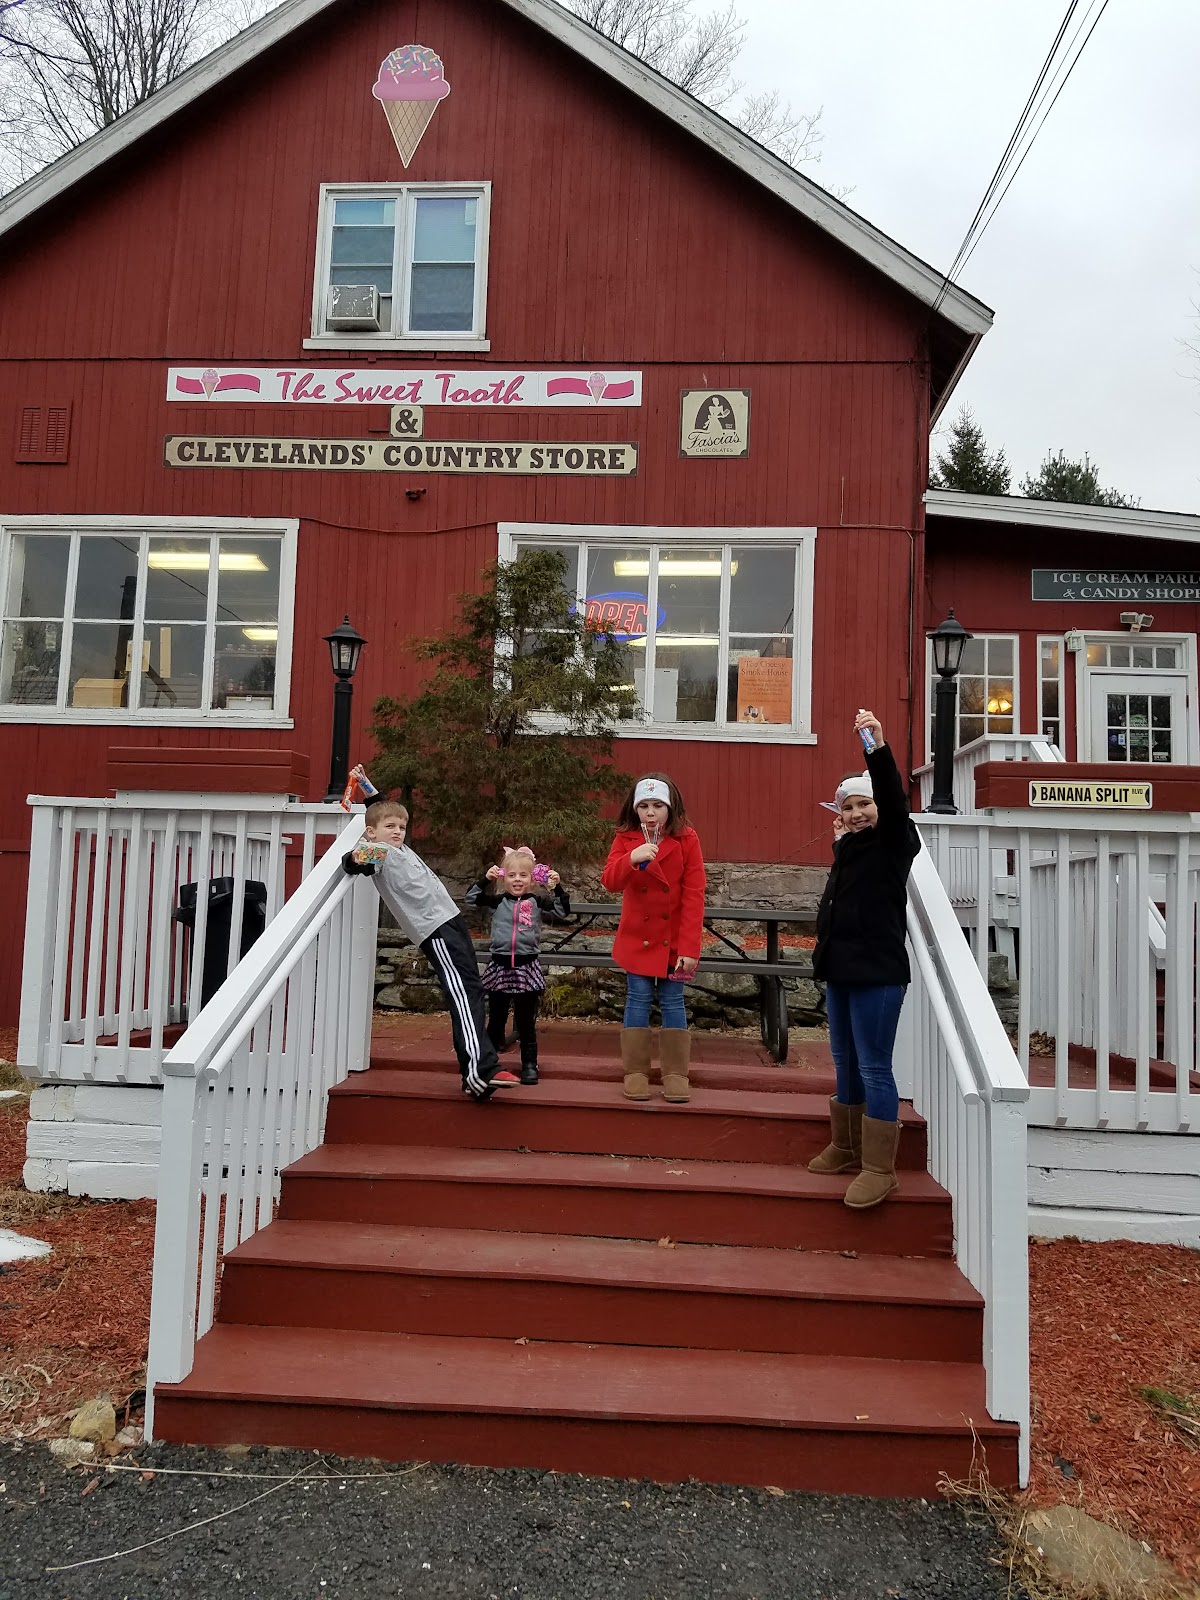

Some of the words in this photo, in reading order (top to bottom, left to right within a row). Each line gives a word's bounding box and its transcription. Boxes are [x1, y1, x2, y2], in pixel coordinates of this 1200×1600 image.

[276, 371, 326, 401] The
[333, 372, 424, 403] Sweet
[434, 373, 525, 404] Tooth
[395, 408, 418, 434] &
[687, 431, 741, 449] Fascia's
[177, 441, 373, 466] CLEVELANDS'
[383, 445, 523, 469] COUNTRY
[529, 447, 626, 470] STORE
[1052, 572, 1081, 583] ICE
[1085, 573, 1150, 584] CREAM
[1154, 573, 1200, 584] PARL
[1063, 588, 1076, 599] &
[1080, 587, 1141, 599] CANDY
[584, 600, 648, 633] OPEN
[741, 668, 765, 676] Smoke
[767, 668, 789, 677] House
[1040, 786, 1092, 802] BANANA
[1095, 788, 1129, 803] SPLIT
